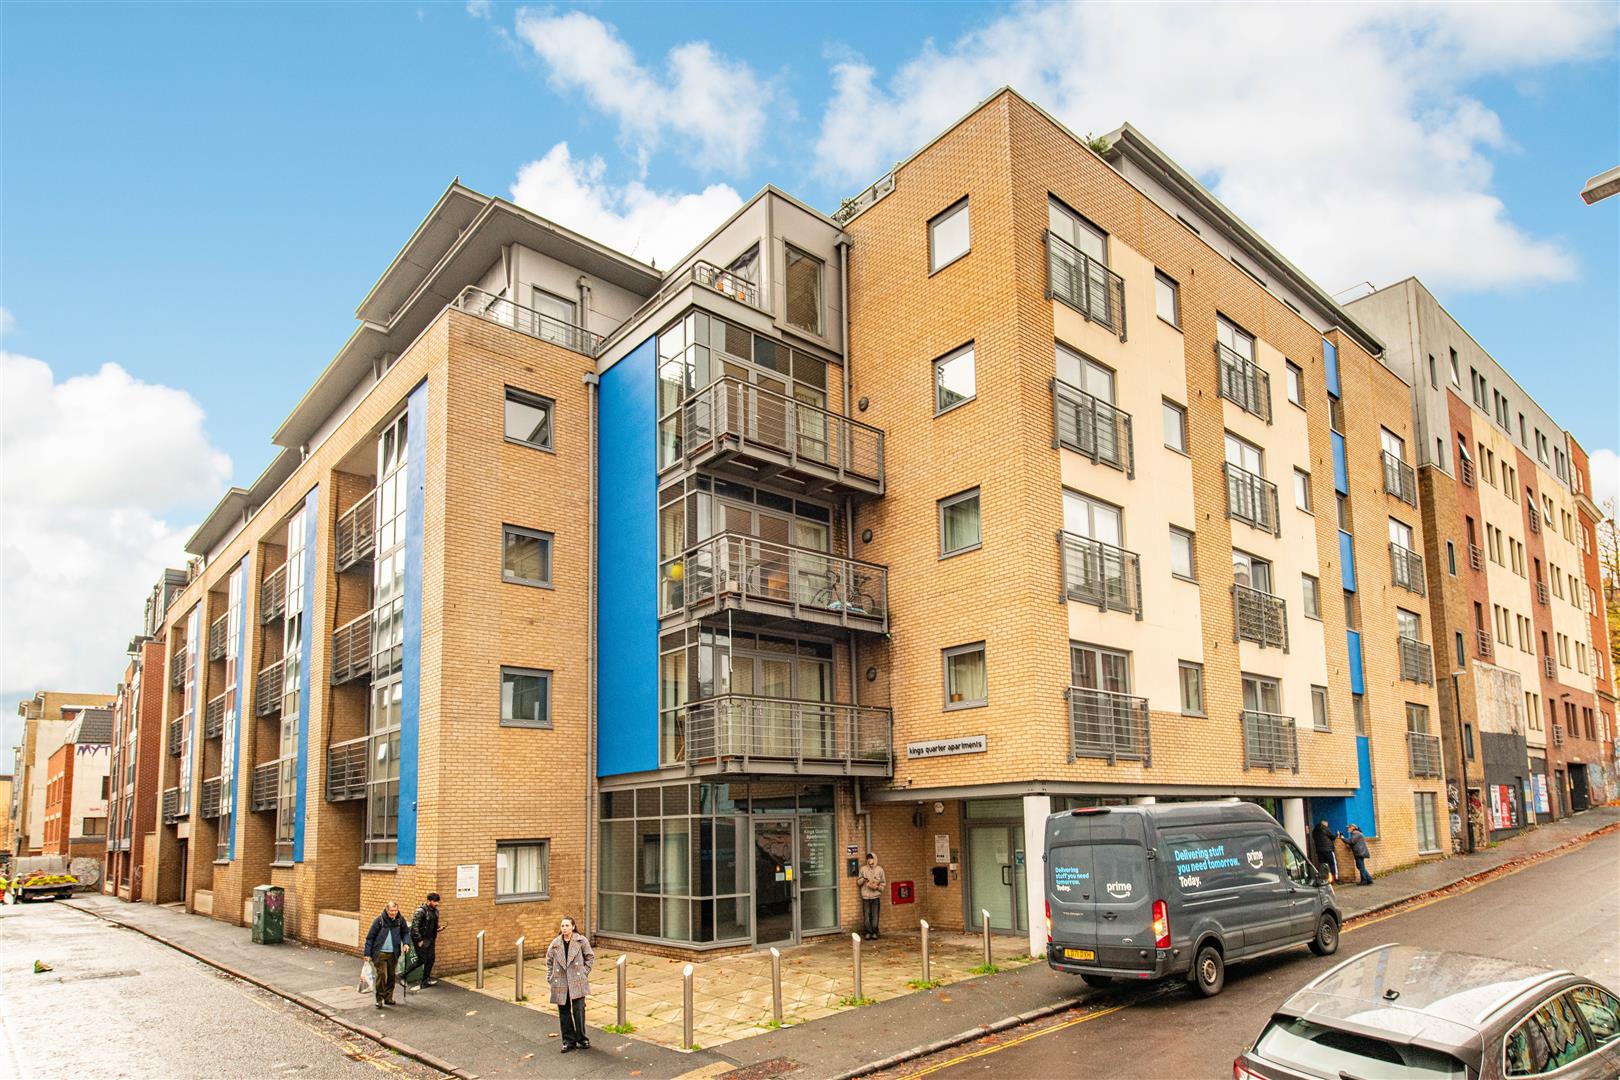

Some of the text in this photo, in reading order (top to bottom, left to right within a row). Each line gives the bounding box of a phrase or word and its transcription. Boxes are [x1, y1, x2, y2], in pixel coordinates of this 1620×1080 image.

[909, 741, 982, 755] kings quarter apartments
[1174, 845, 1225, 861] Delivering stuff
[1246, 849, 1264, 864] prime
[1177, 857, 1240, 875] you need tomorrow.
[1106, 881, 1132, 893] prime
[1178, 875, 1202, 888] Today.
